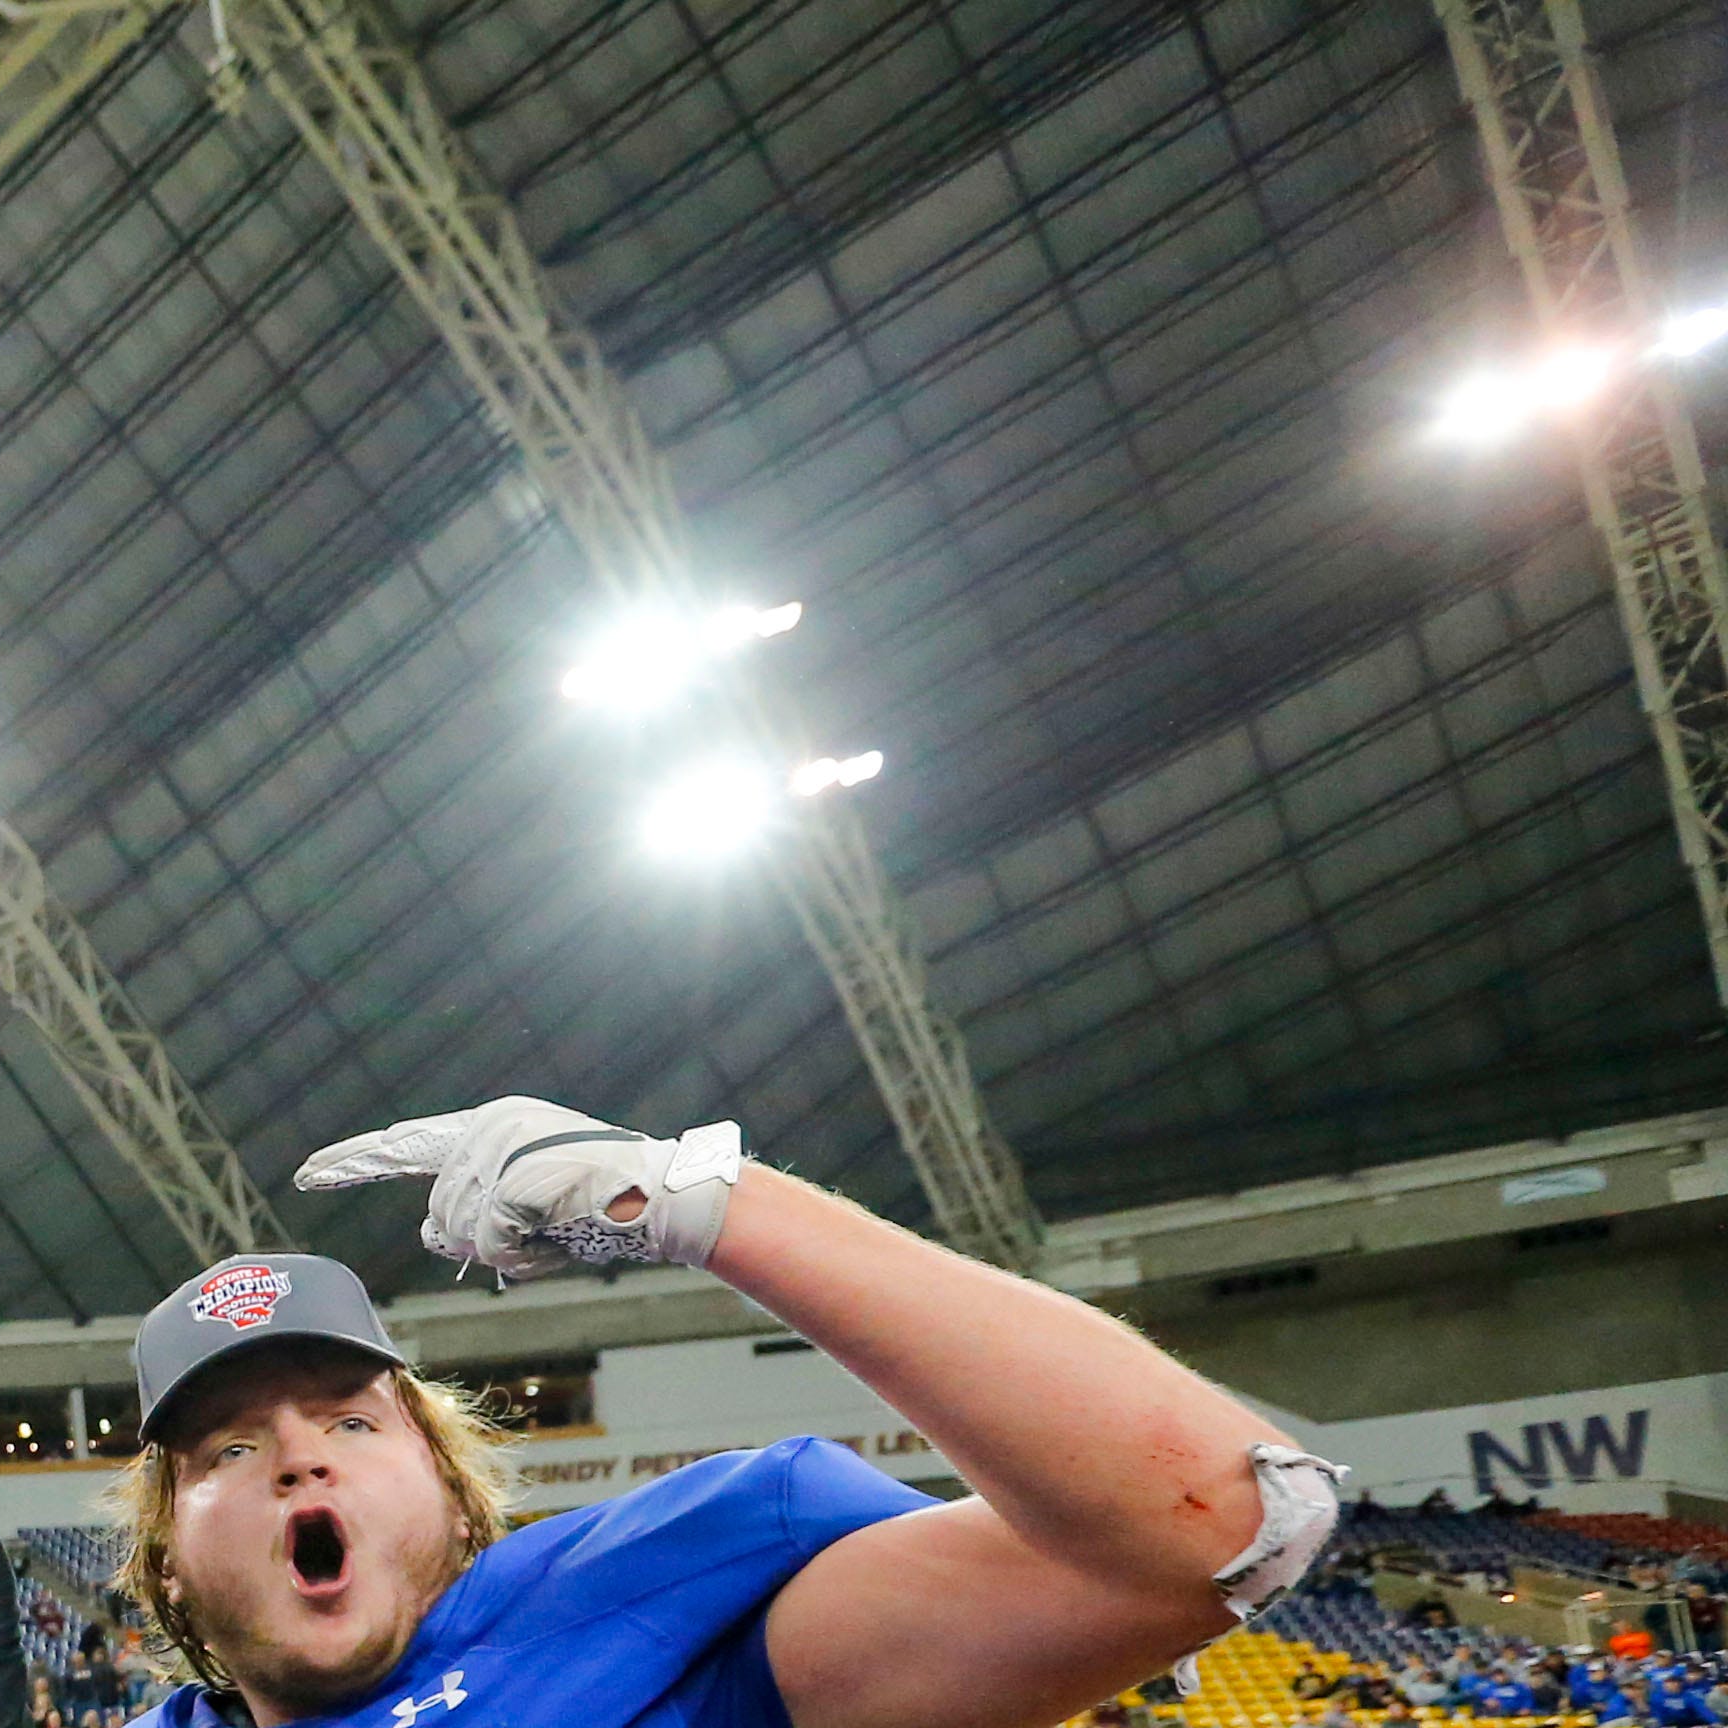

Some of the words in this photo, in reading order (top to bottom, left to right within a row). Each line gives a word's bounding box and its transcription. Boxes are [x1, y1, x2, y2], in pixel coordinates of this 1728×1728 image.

[194, 1273, 291, 1319] CHAMPION
[216, 1268, 254, 1286] STATE
[1467, 1408, 1651, 1495] NW
